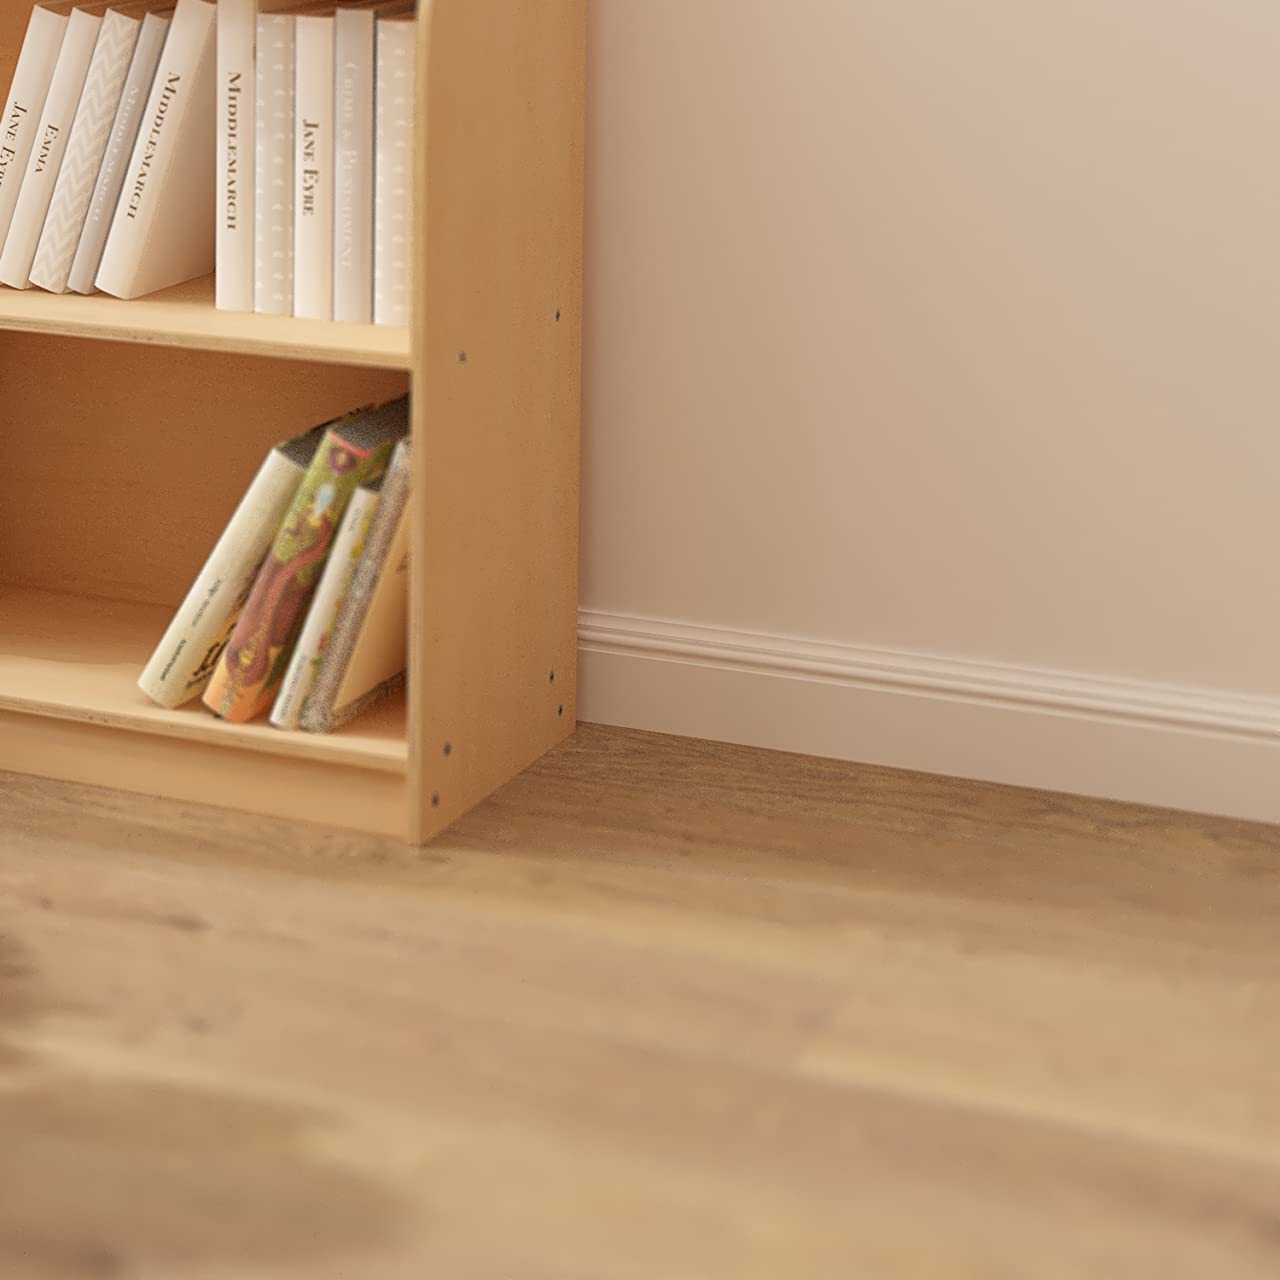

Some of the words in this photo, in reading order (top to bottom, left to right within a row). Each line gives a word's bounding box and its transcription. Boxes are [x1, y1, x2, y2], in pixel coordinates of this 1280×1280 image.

[5, 101, 27, 141] JANE
[302, 118, 320, 162] JANE
[34, 124, 59, 173] EMMA
[127, 72, 180, 219] MIDDLEMARCH
[226, 72, 242, 230] MIDDLEMARCH
[302, 169, 320, 217] EYRE
